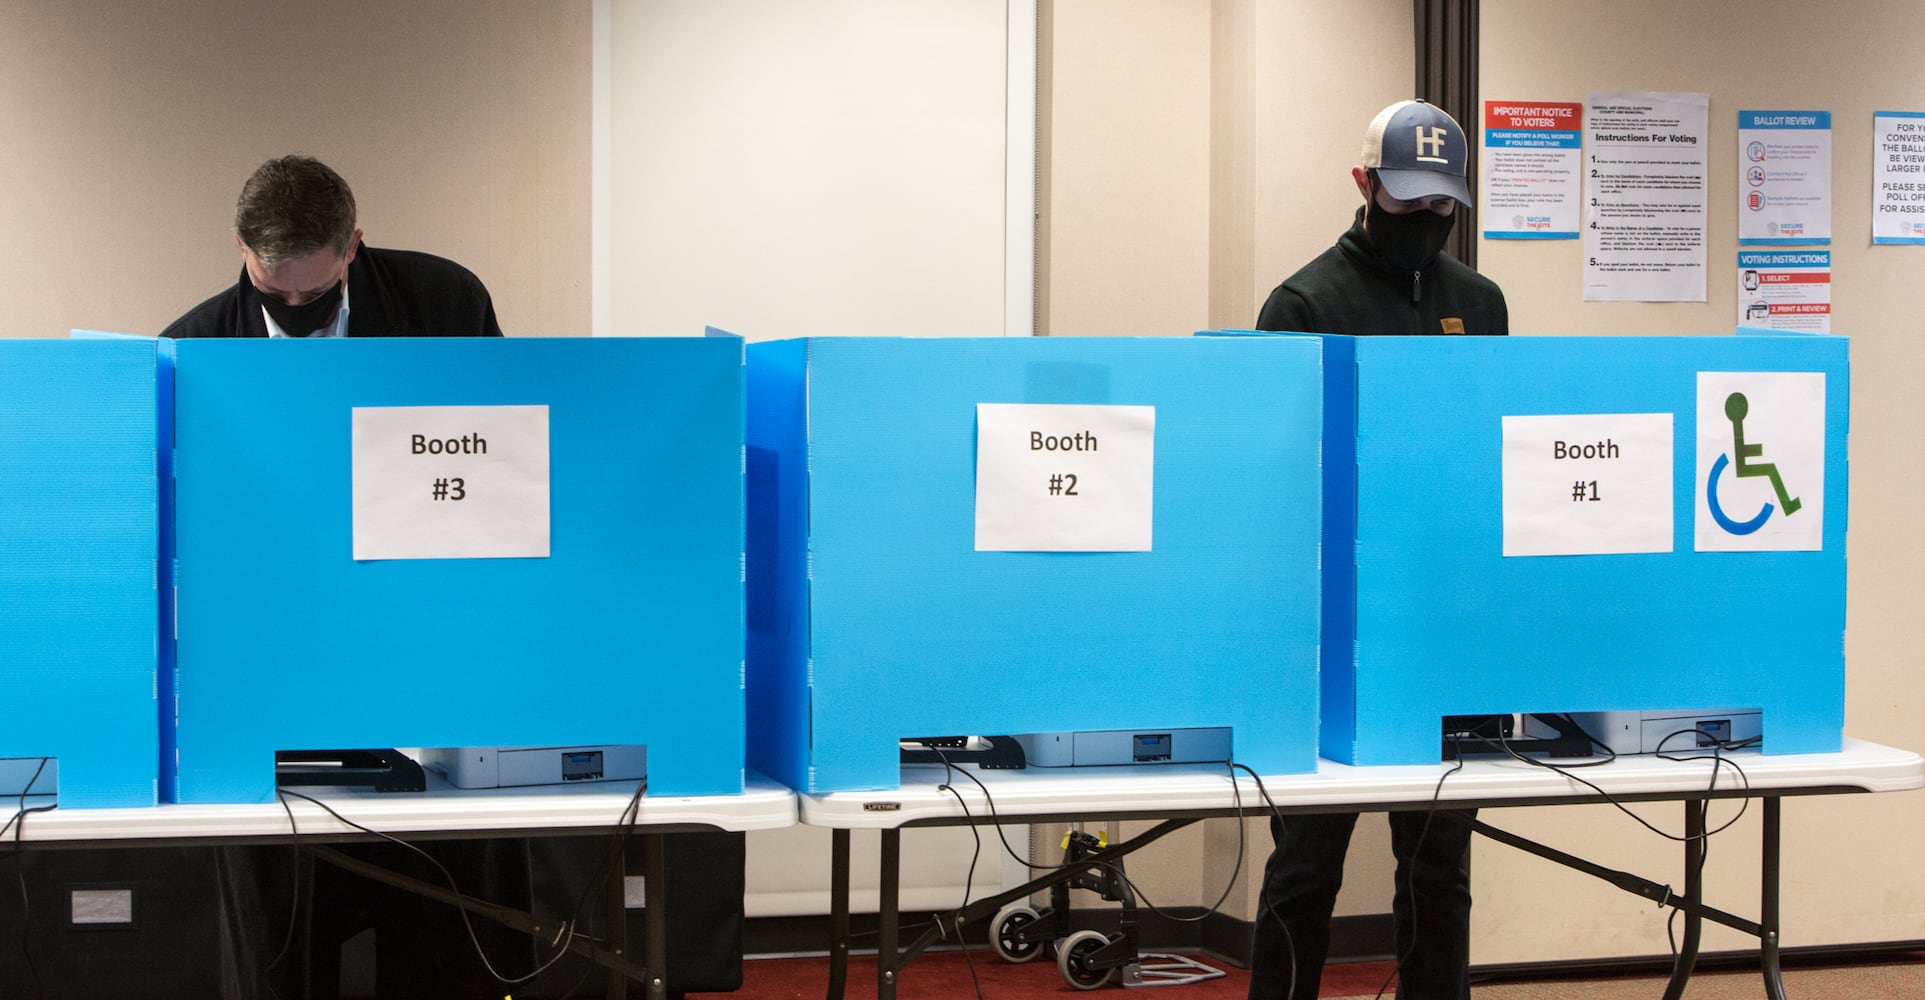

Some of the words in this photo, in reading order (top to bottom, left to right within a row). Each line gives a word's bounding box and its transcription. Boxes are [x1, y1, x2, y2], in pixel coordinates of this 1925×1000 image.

[1493, 106, 1541, 116] IMPORTANT
[1542, 108, 1572, 117] NOTICE
[1510, 118, 1522, 126] TO
[1523, 118, 1555, 127] VOTERS
[1754, 117, 1784, 125] BALLOT
[1785, 117, 1816, 125] REVIEW
[1897, 124, 1915, 132] FOR
[1416, 126, 1447, 157] HF
[1595, 133, 1650, 142] Instructions
[1652, 134, 1667, 142] For
[1669, 134, 1697, 144] Voting
[1882, 144, 1899, 152] THE
[1591, 155, 1600, 163] 1.
[1890, 154, 1901, 162] BE
[1887, 164, 1920, 173] LARGER
[1591, 170, 1600, 178] 2.
[1883, 183, 1915, 191] PLEASE
[1887, 193, 1908, 201] POLL
[1591, 198, 1600, 207] 3.
[1880, 205, 1897, 213] FOR
[1900, 205, 1925, 213] ASSIS
[1590, 222, 1600, 230] 4.
[1590, 258, 1599, 266] 5.
[1741, 255, 1770, 264] VOTING
[1772, 255, 1828, 264] INSTRUCTIONS
[412, 433, 487, 455] Booth
[1031, 431, 1097, 451] Booth
[1554, 439, 1619, 459] Booth
[432, 478, 466, 501] #3
[1049, 475, 1078, 496] #2
[1572, 481, 1601, 501] #1
